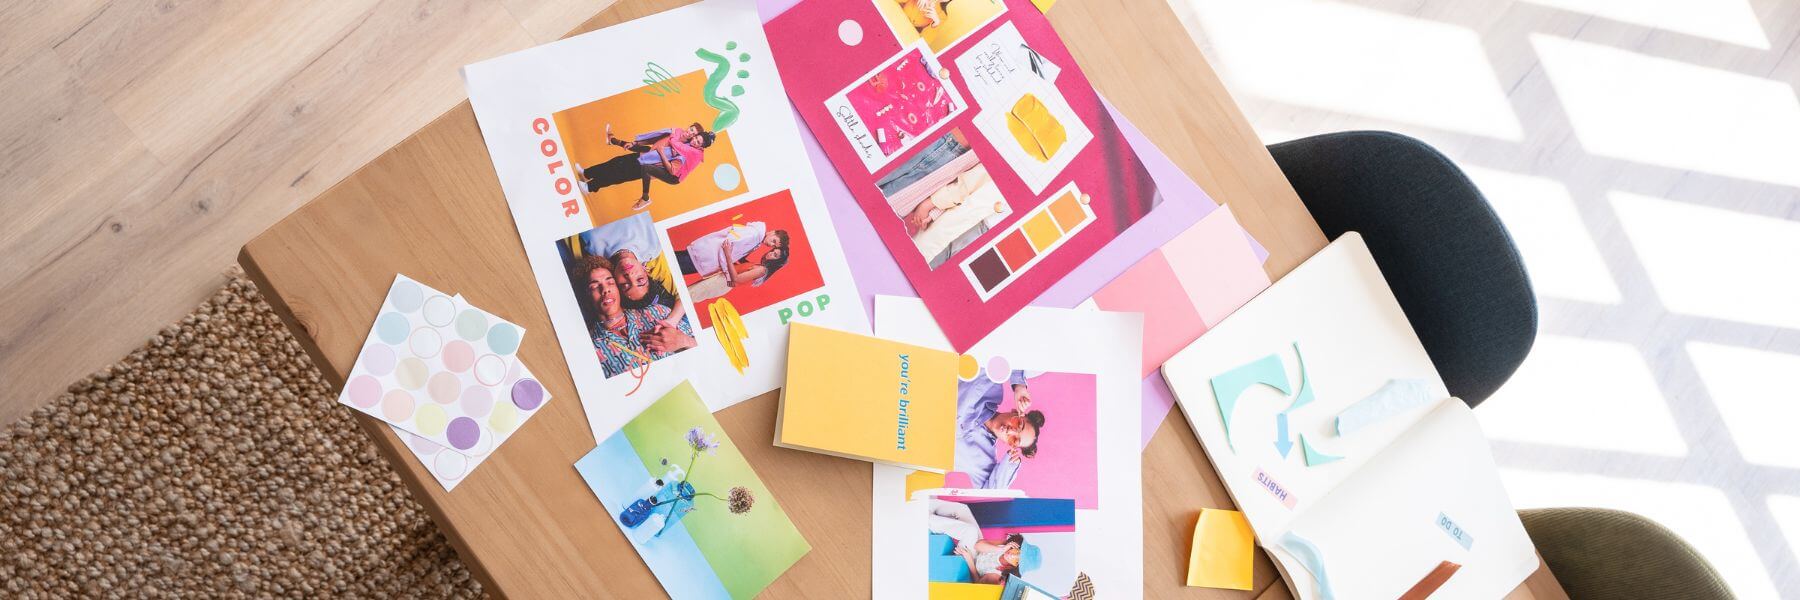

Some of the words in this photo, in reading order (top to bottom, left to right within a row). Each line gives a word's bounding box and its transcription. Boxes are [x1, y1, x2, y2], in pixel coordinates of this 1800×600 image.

[836, 105, 859, 132] Subtle
[854, 133, 873, 159] shades
[531, 117, 580, 219] COLOR
[777, 294, 831, 325] POP
[898, 353, 912, 395] you're
[896, 398, 911, 450] brilliant
[1257, 471, 1288, 501] HABITS
[1441, 516, 1452, 530] DO
[1453, 527, 1463, 541] TO
